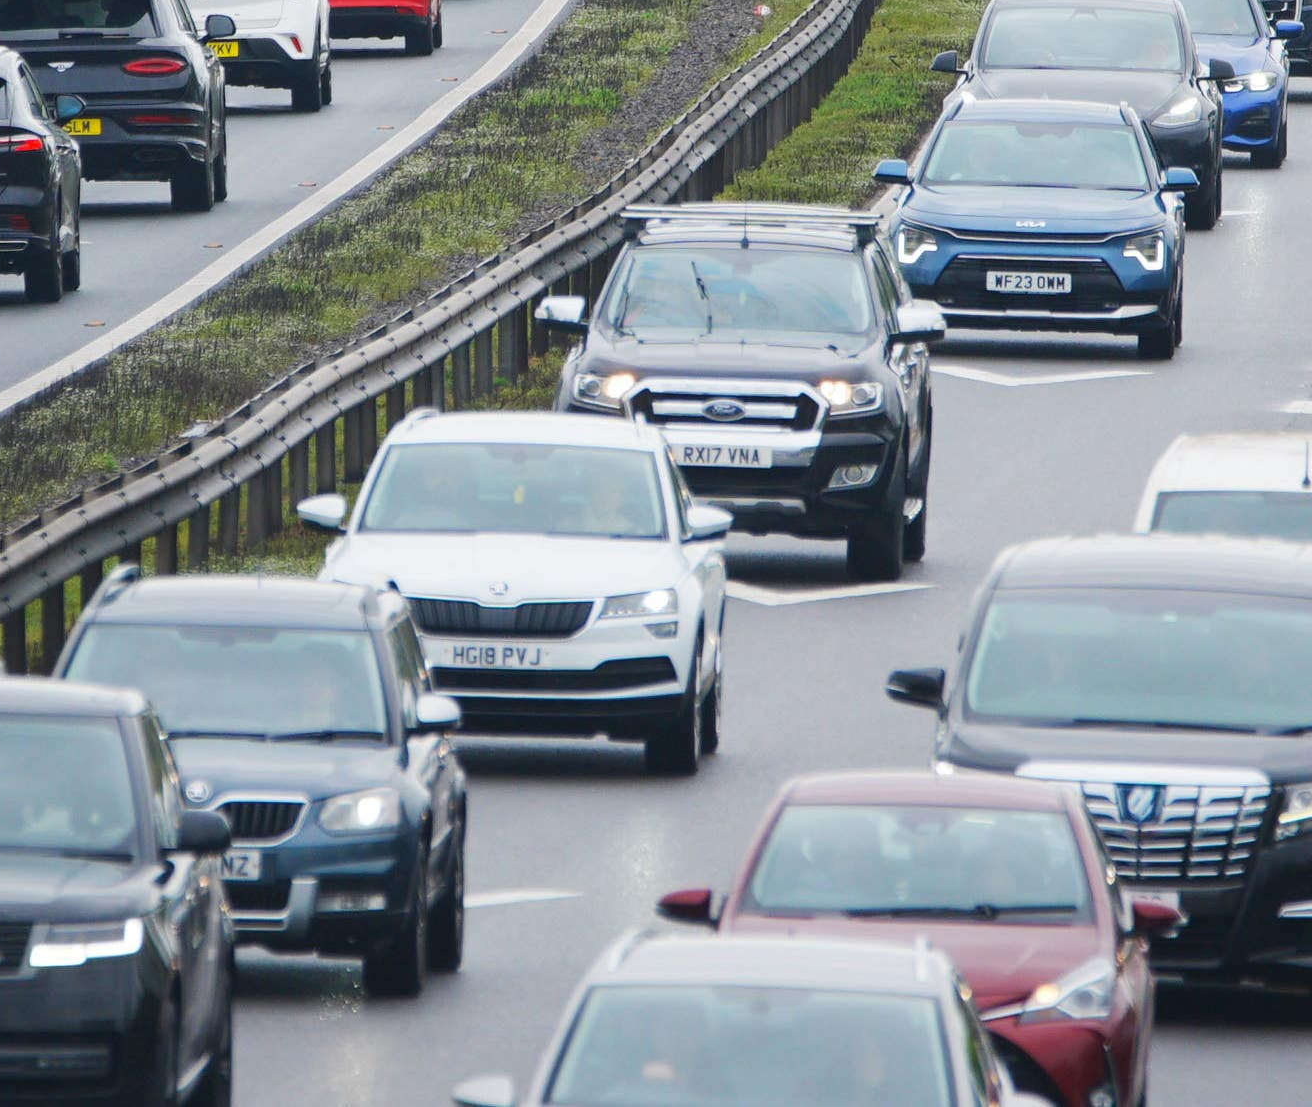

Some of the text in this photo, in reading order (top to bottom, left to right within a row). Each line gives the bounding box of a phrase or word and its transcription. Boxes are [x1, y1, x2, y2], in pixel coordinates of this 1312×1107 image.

[995, 275, 1065, 290] WF23 OWM
[683, 447, 760, 464] RX17 VNA
[453, 646, 541, 666] HG18 PVJ
[220, 856, 249, 877] NZ
